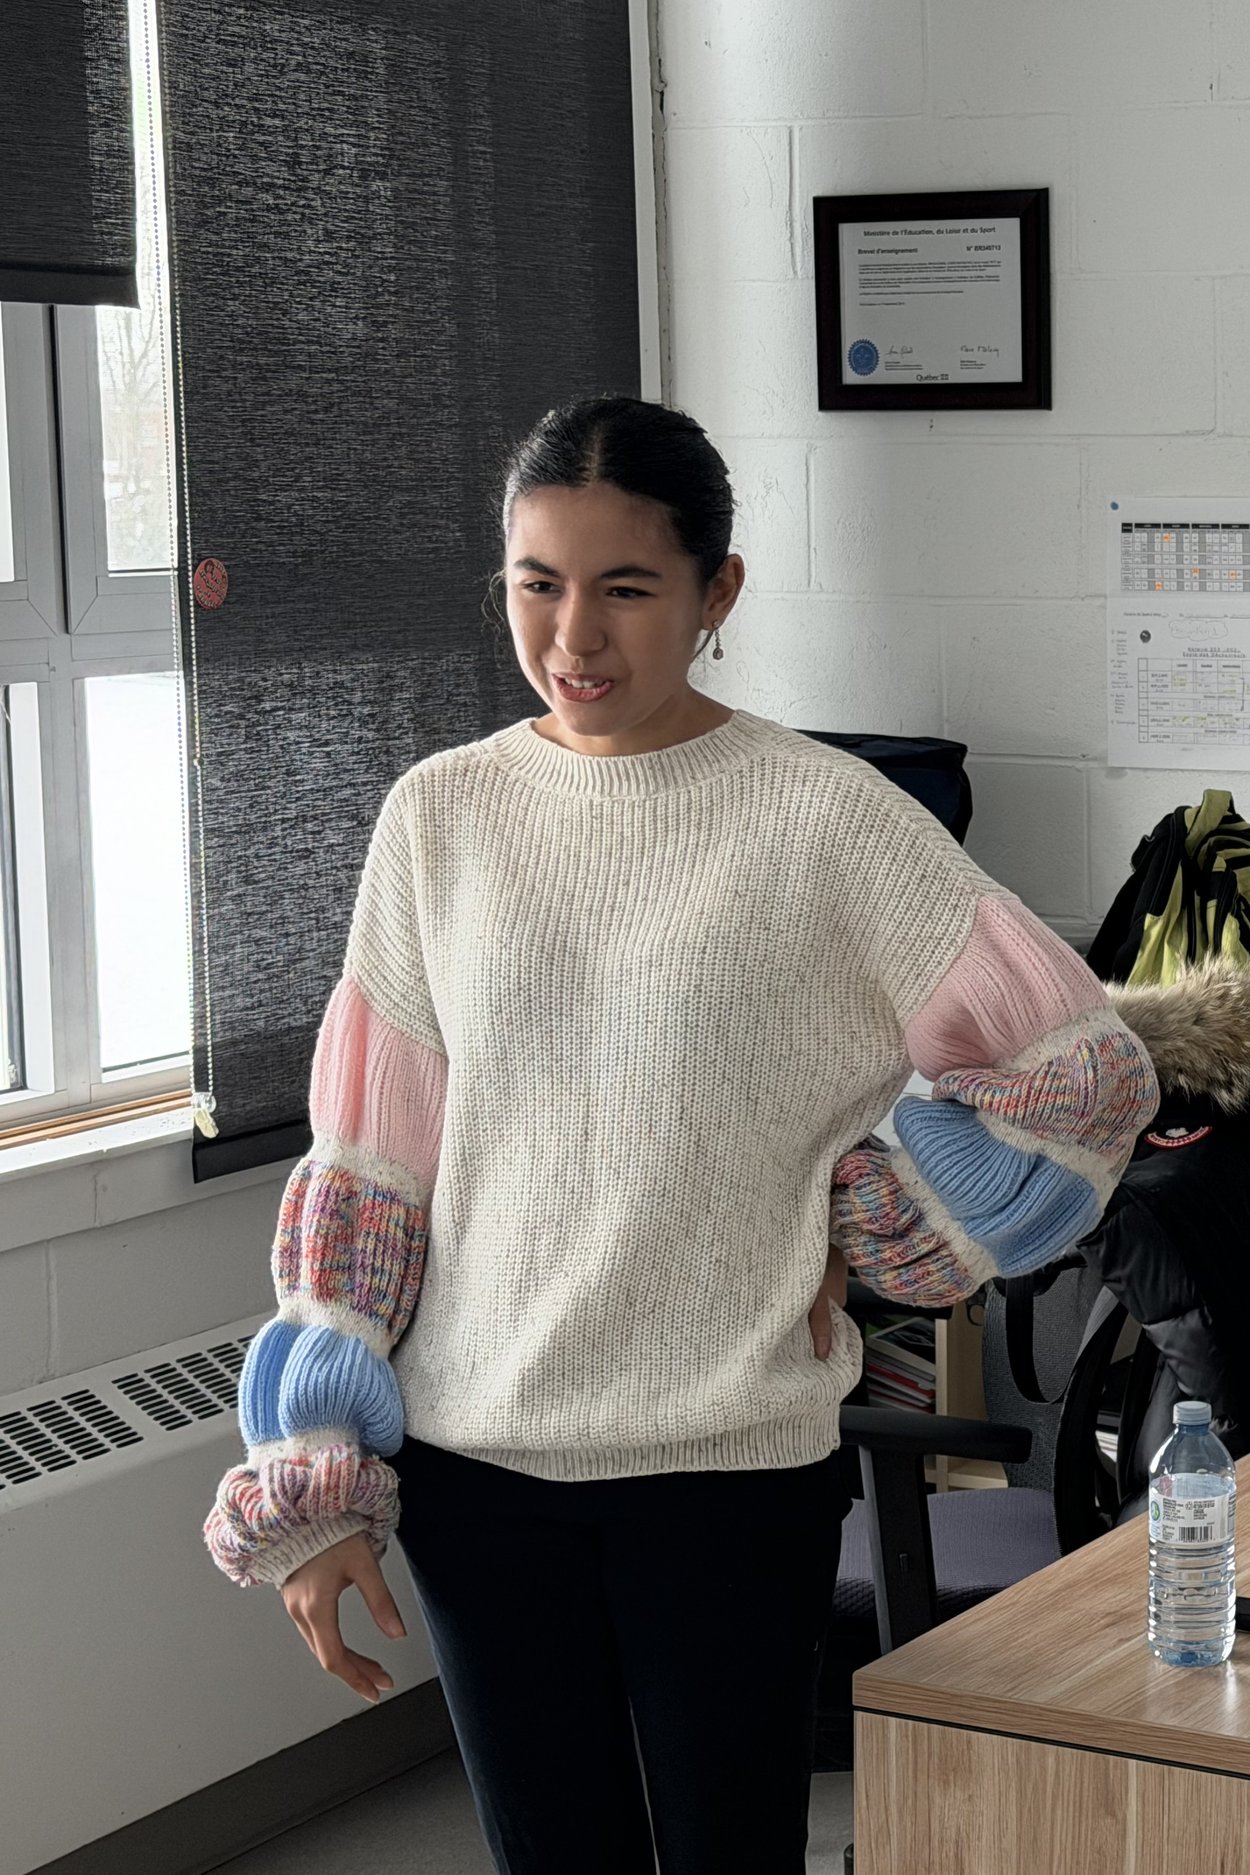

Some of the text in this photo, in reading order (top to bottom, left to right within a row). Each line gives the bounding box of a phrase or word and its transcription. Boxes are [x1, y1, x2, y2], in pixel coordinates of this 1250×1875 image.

[979, 226, 996, 235] Sport
[876, 247, 918, 255] d'enseignement
[916, 374, 940, 382] Québec
